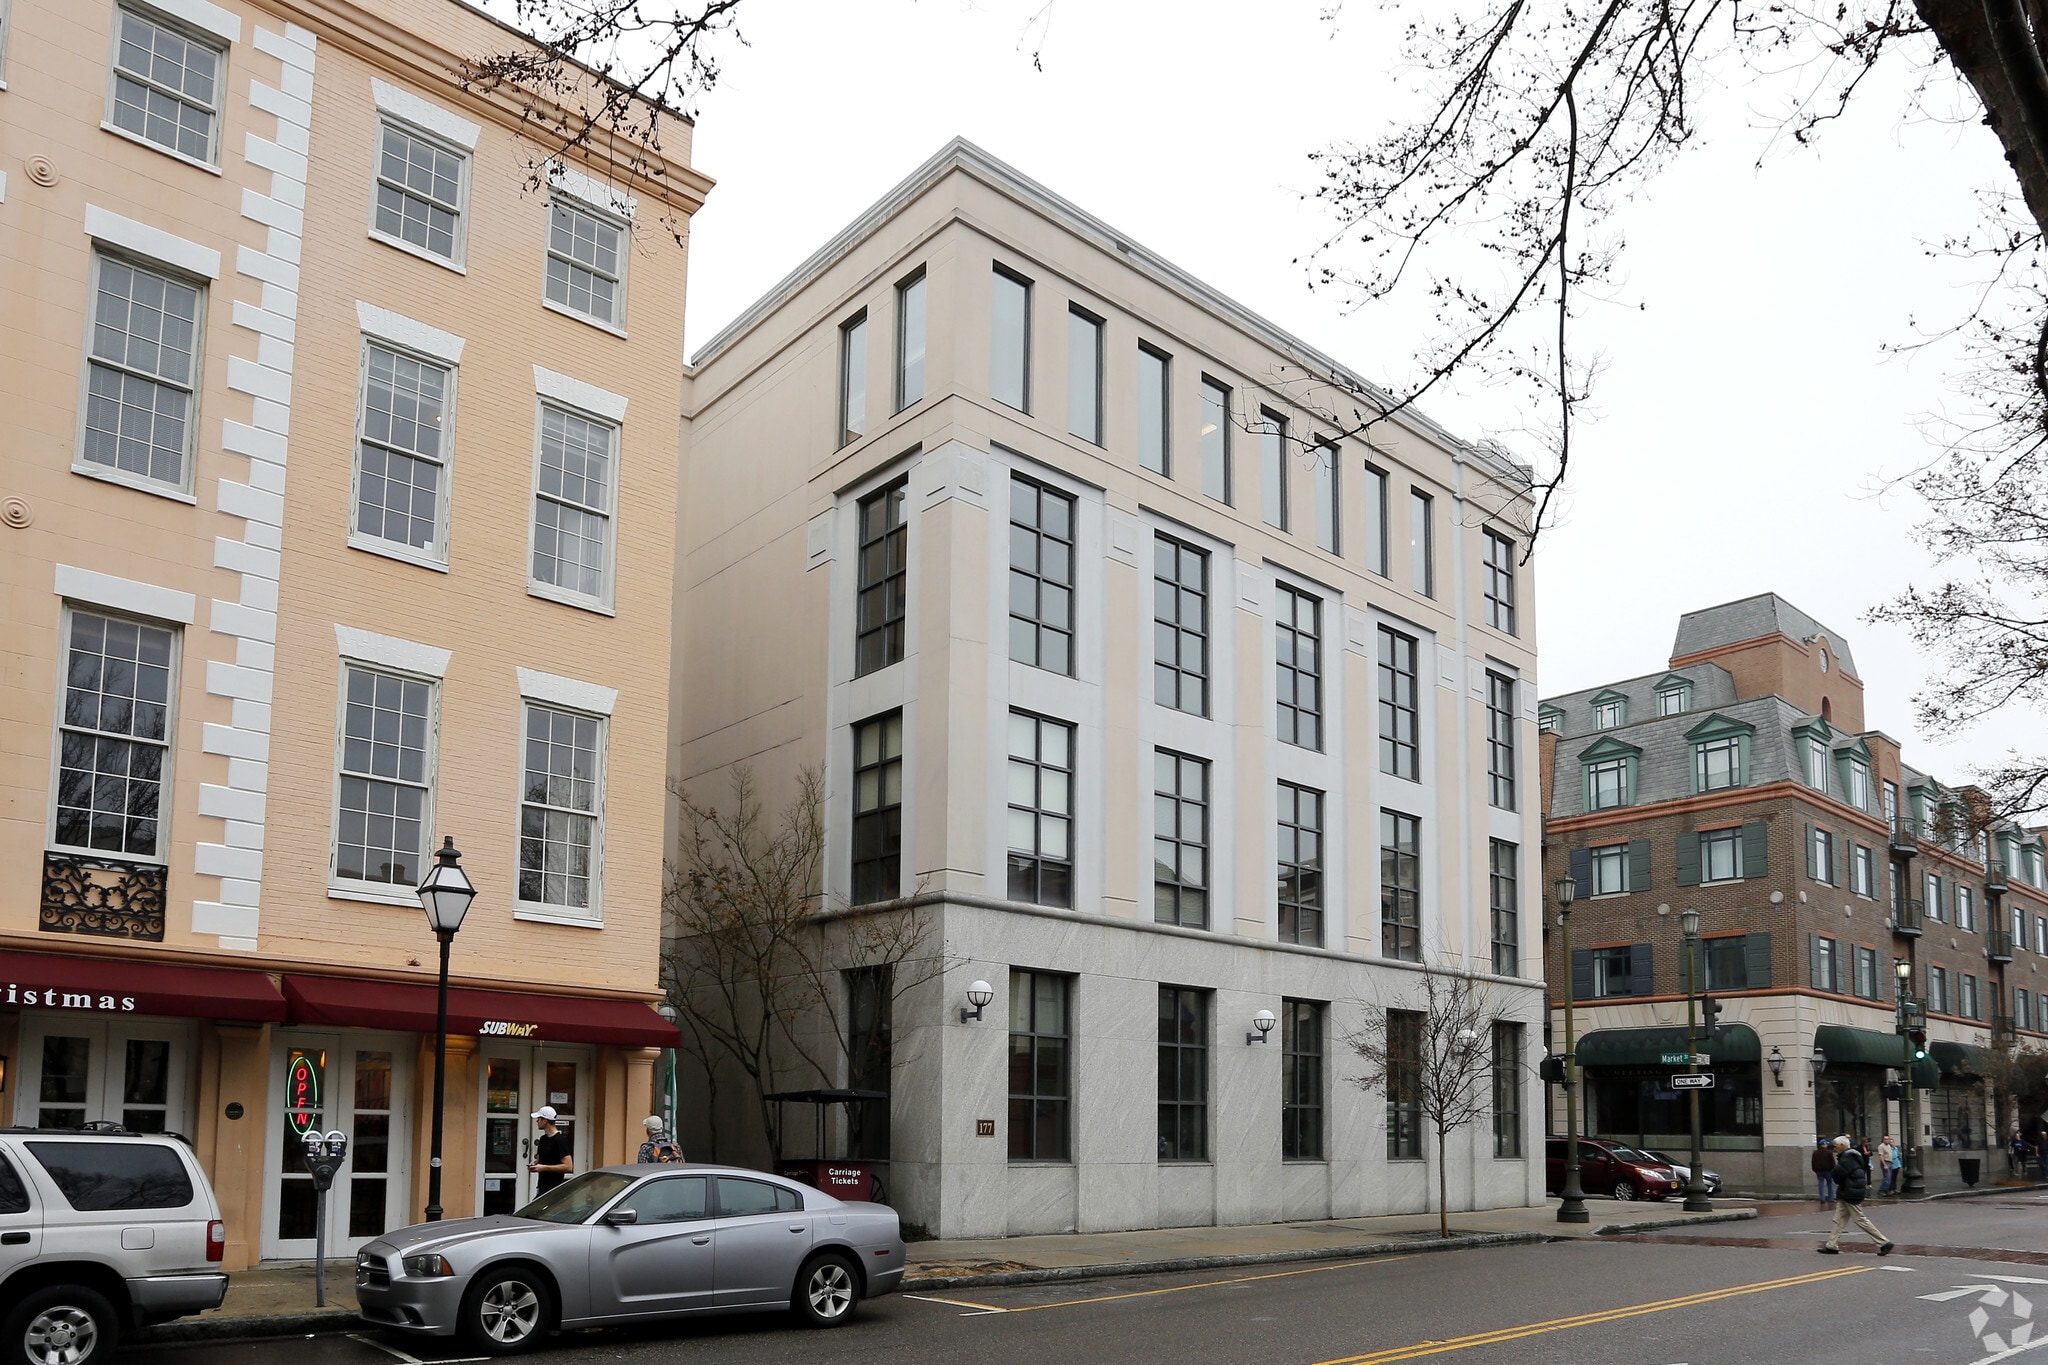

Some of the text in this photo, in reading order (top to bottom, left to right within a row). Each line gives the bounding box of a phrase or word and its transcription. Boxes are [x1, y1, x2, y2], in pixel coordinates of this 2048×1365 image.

[0, 984, 135, 1011] istmas
[479, 1021, 538, 1036] SUBWAY
[1661, 1055, 1683, 1063] Market
[296, 1067, 308, 1125] OPEN
[979, 1122, 992, 1134] 177
[828, 1168, 861, 1177] Carriage
[831, 1177, 859, 1185] Tickets
